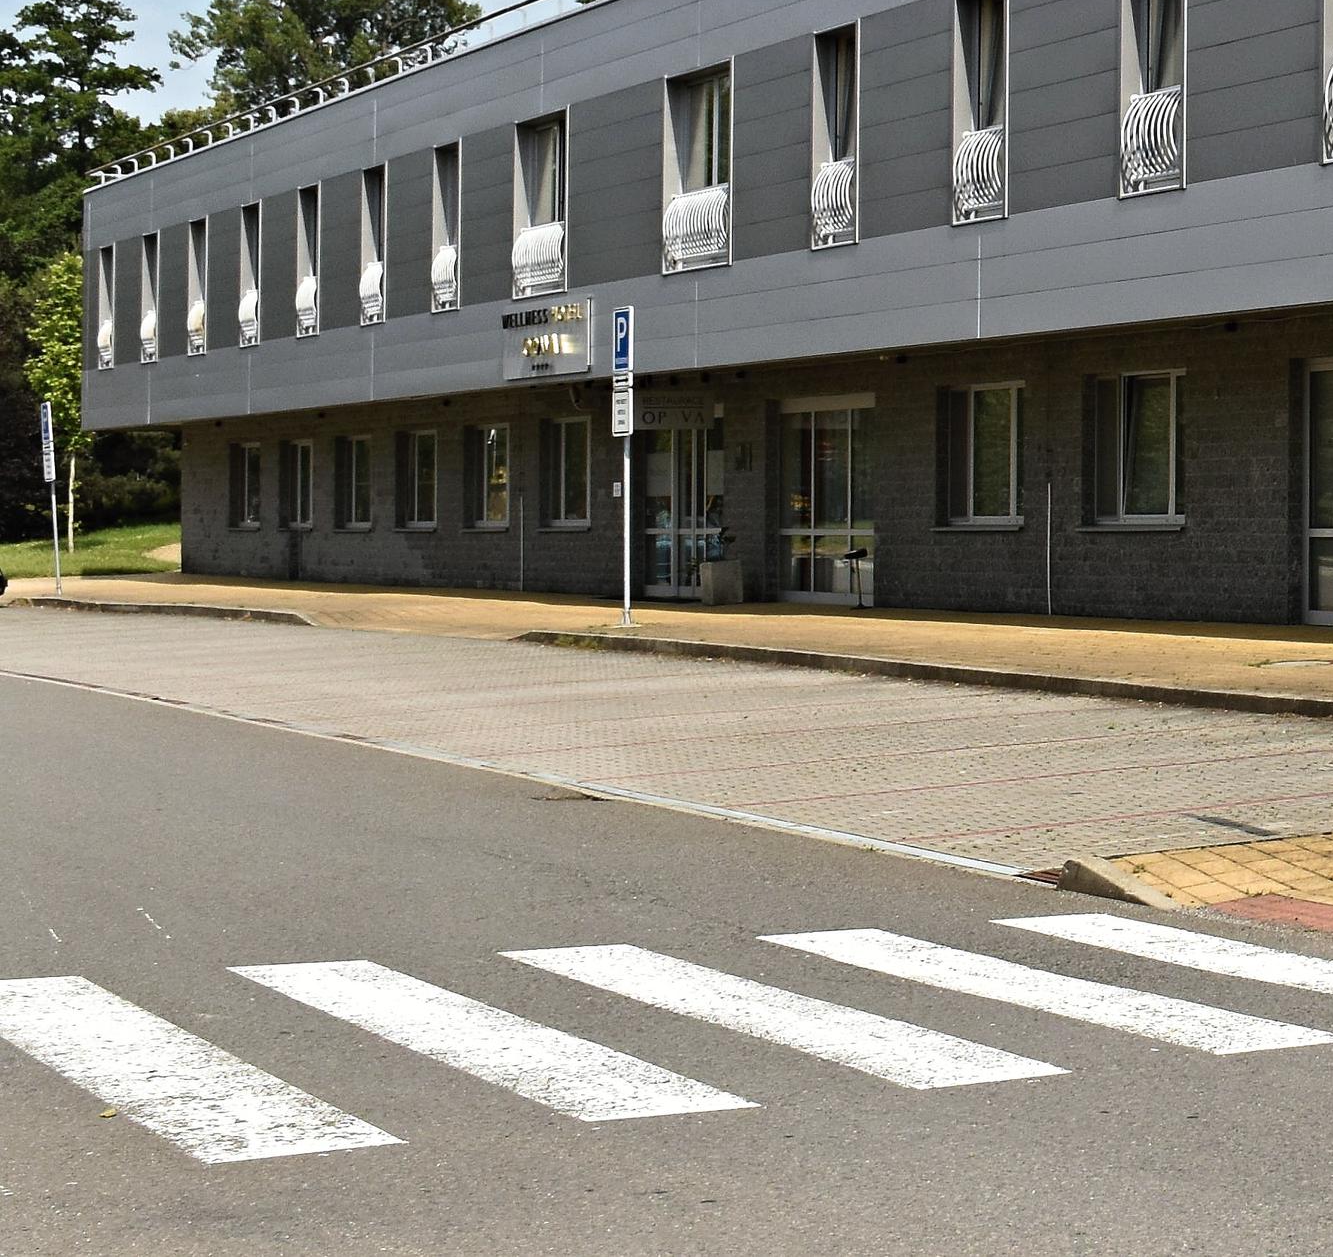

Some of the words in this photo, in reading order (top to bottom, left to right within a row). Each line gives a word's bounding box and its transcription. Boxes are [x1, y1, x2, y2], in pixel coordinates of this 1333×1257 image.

[502, 309, 548, 329] WELLNESS
[616, 317, 627, 353] P
[642, 409, 706, 424] OPVA
